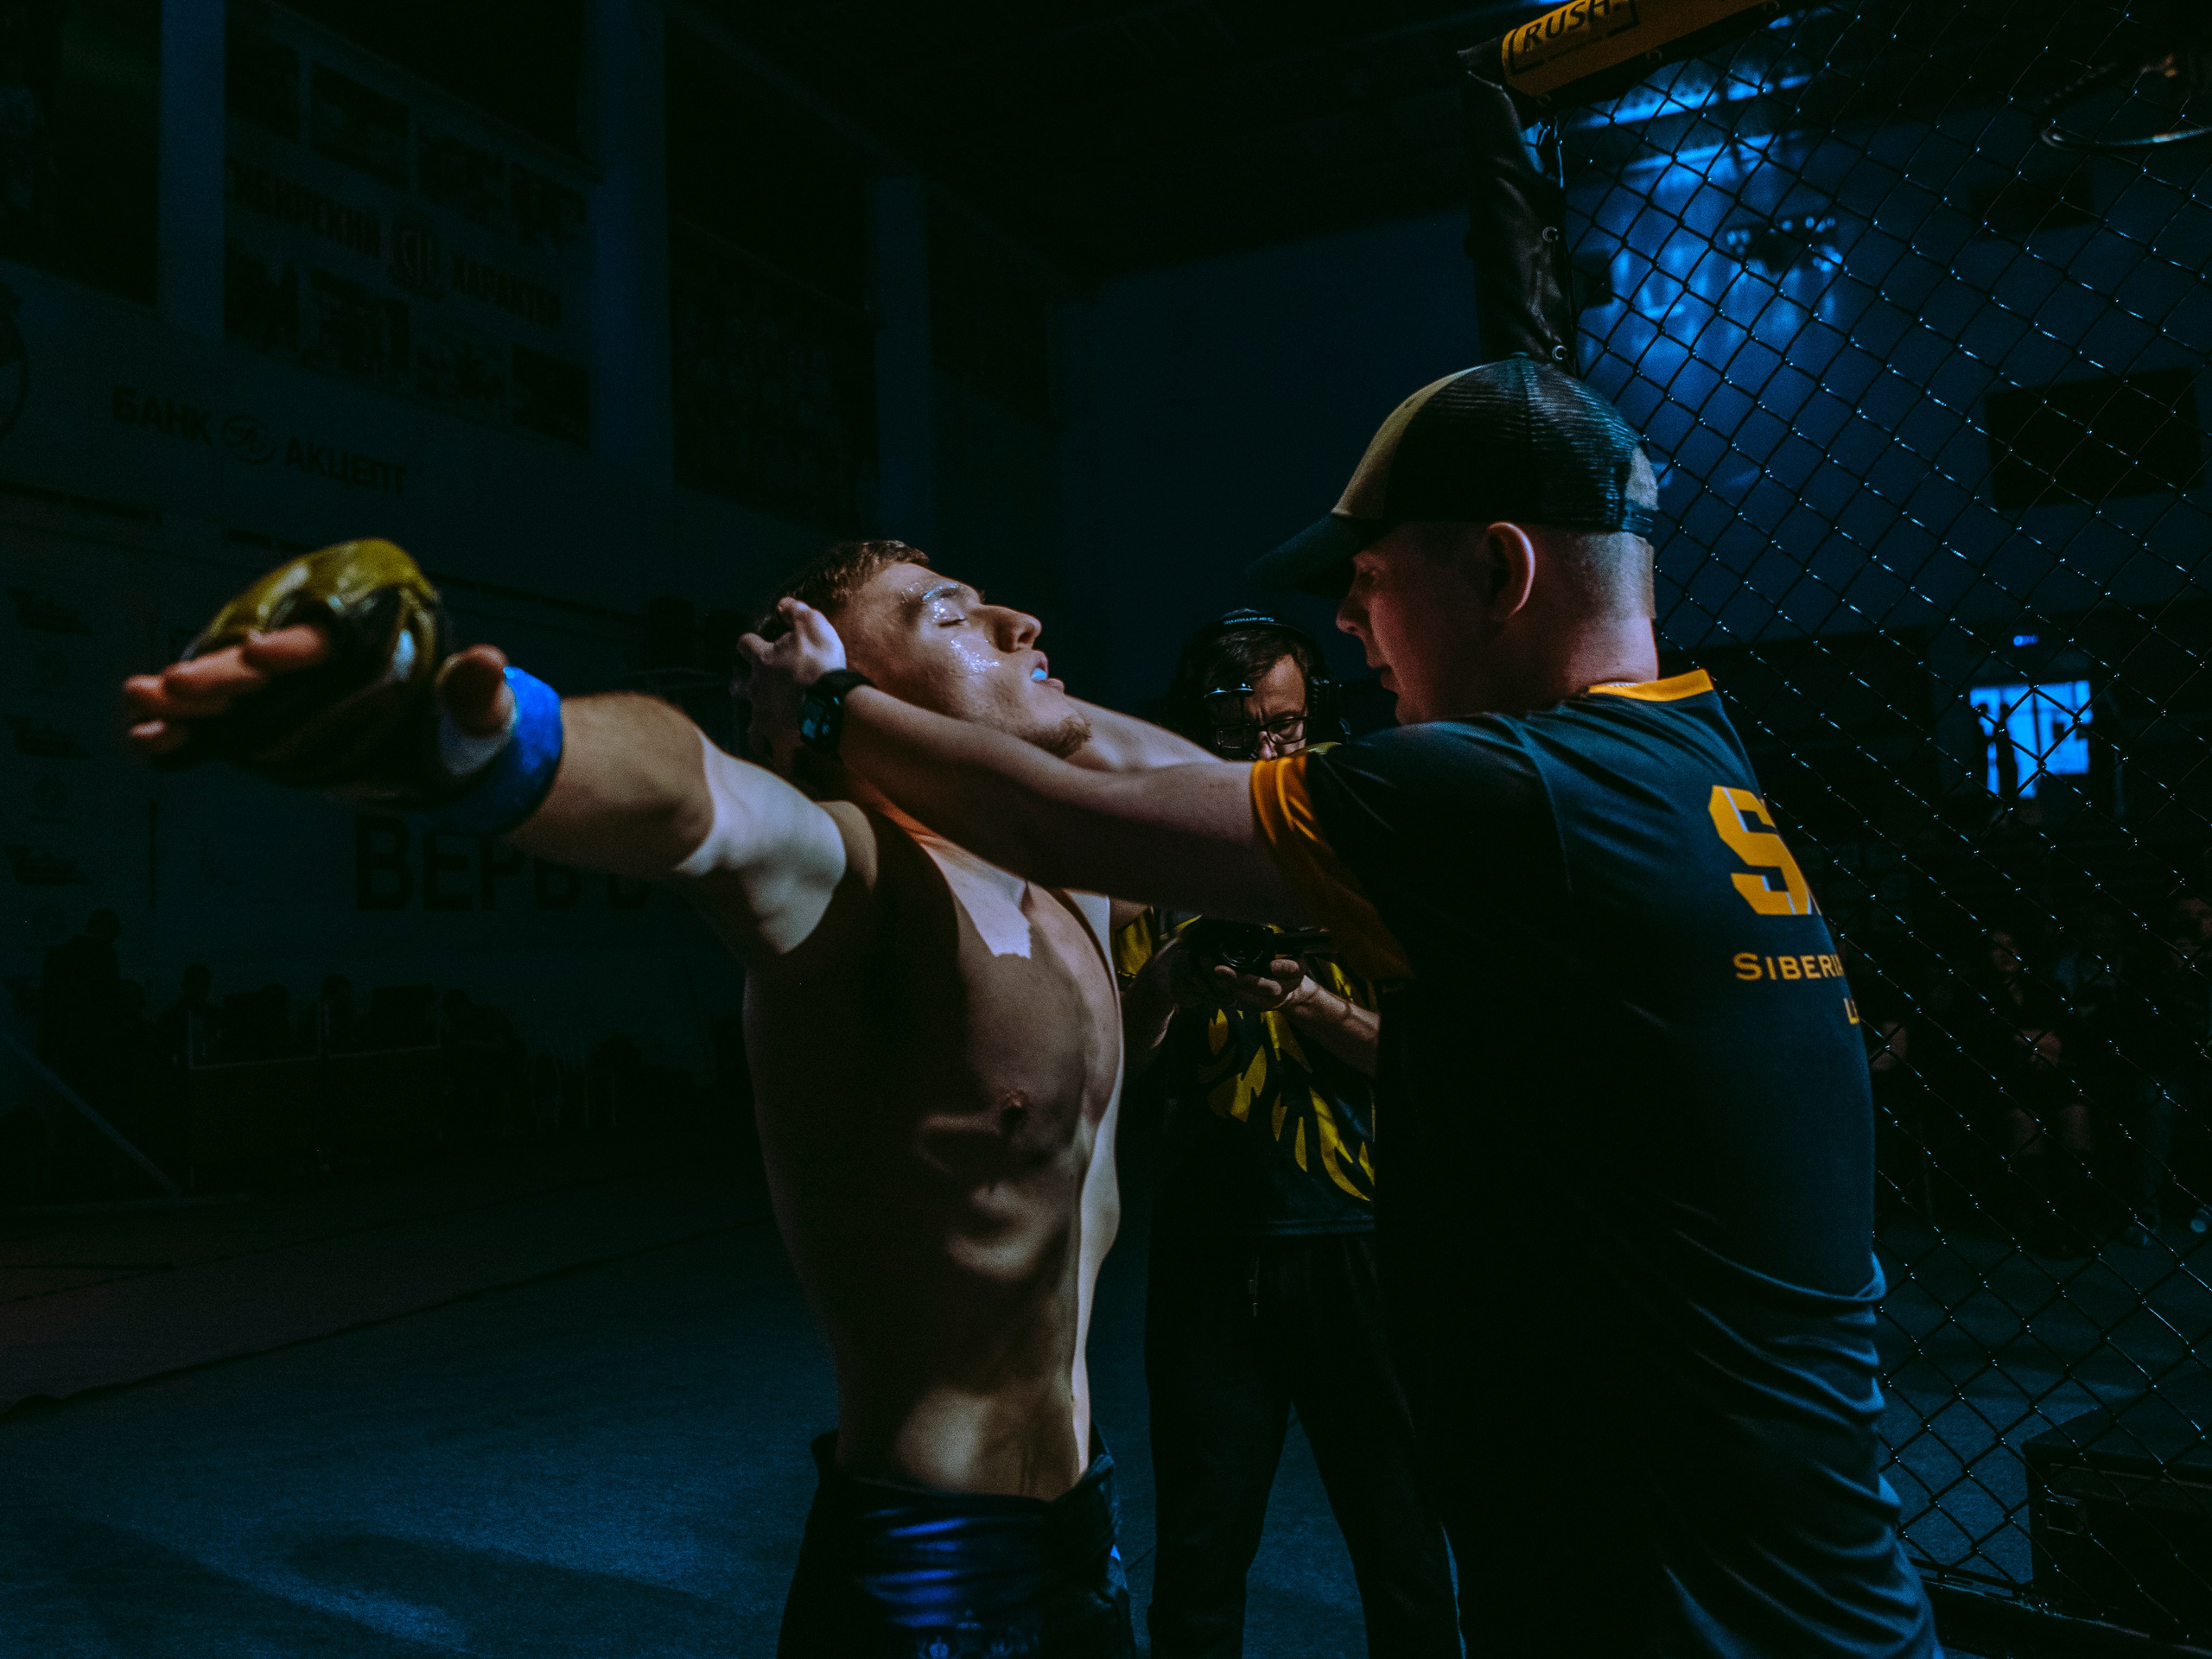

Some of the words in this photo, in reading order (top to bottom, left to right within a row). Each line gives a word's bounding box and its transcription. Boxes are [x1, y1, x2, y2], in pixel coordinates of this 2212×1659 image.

[112, 385, 213, 446] БАНК
[283, 435, 406, 495] АКЦЕПТ
[1707, 784, 1821, 916] S
